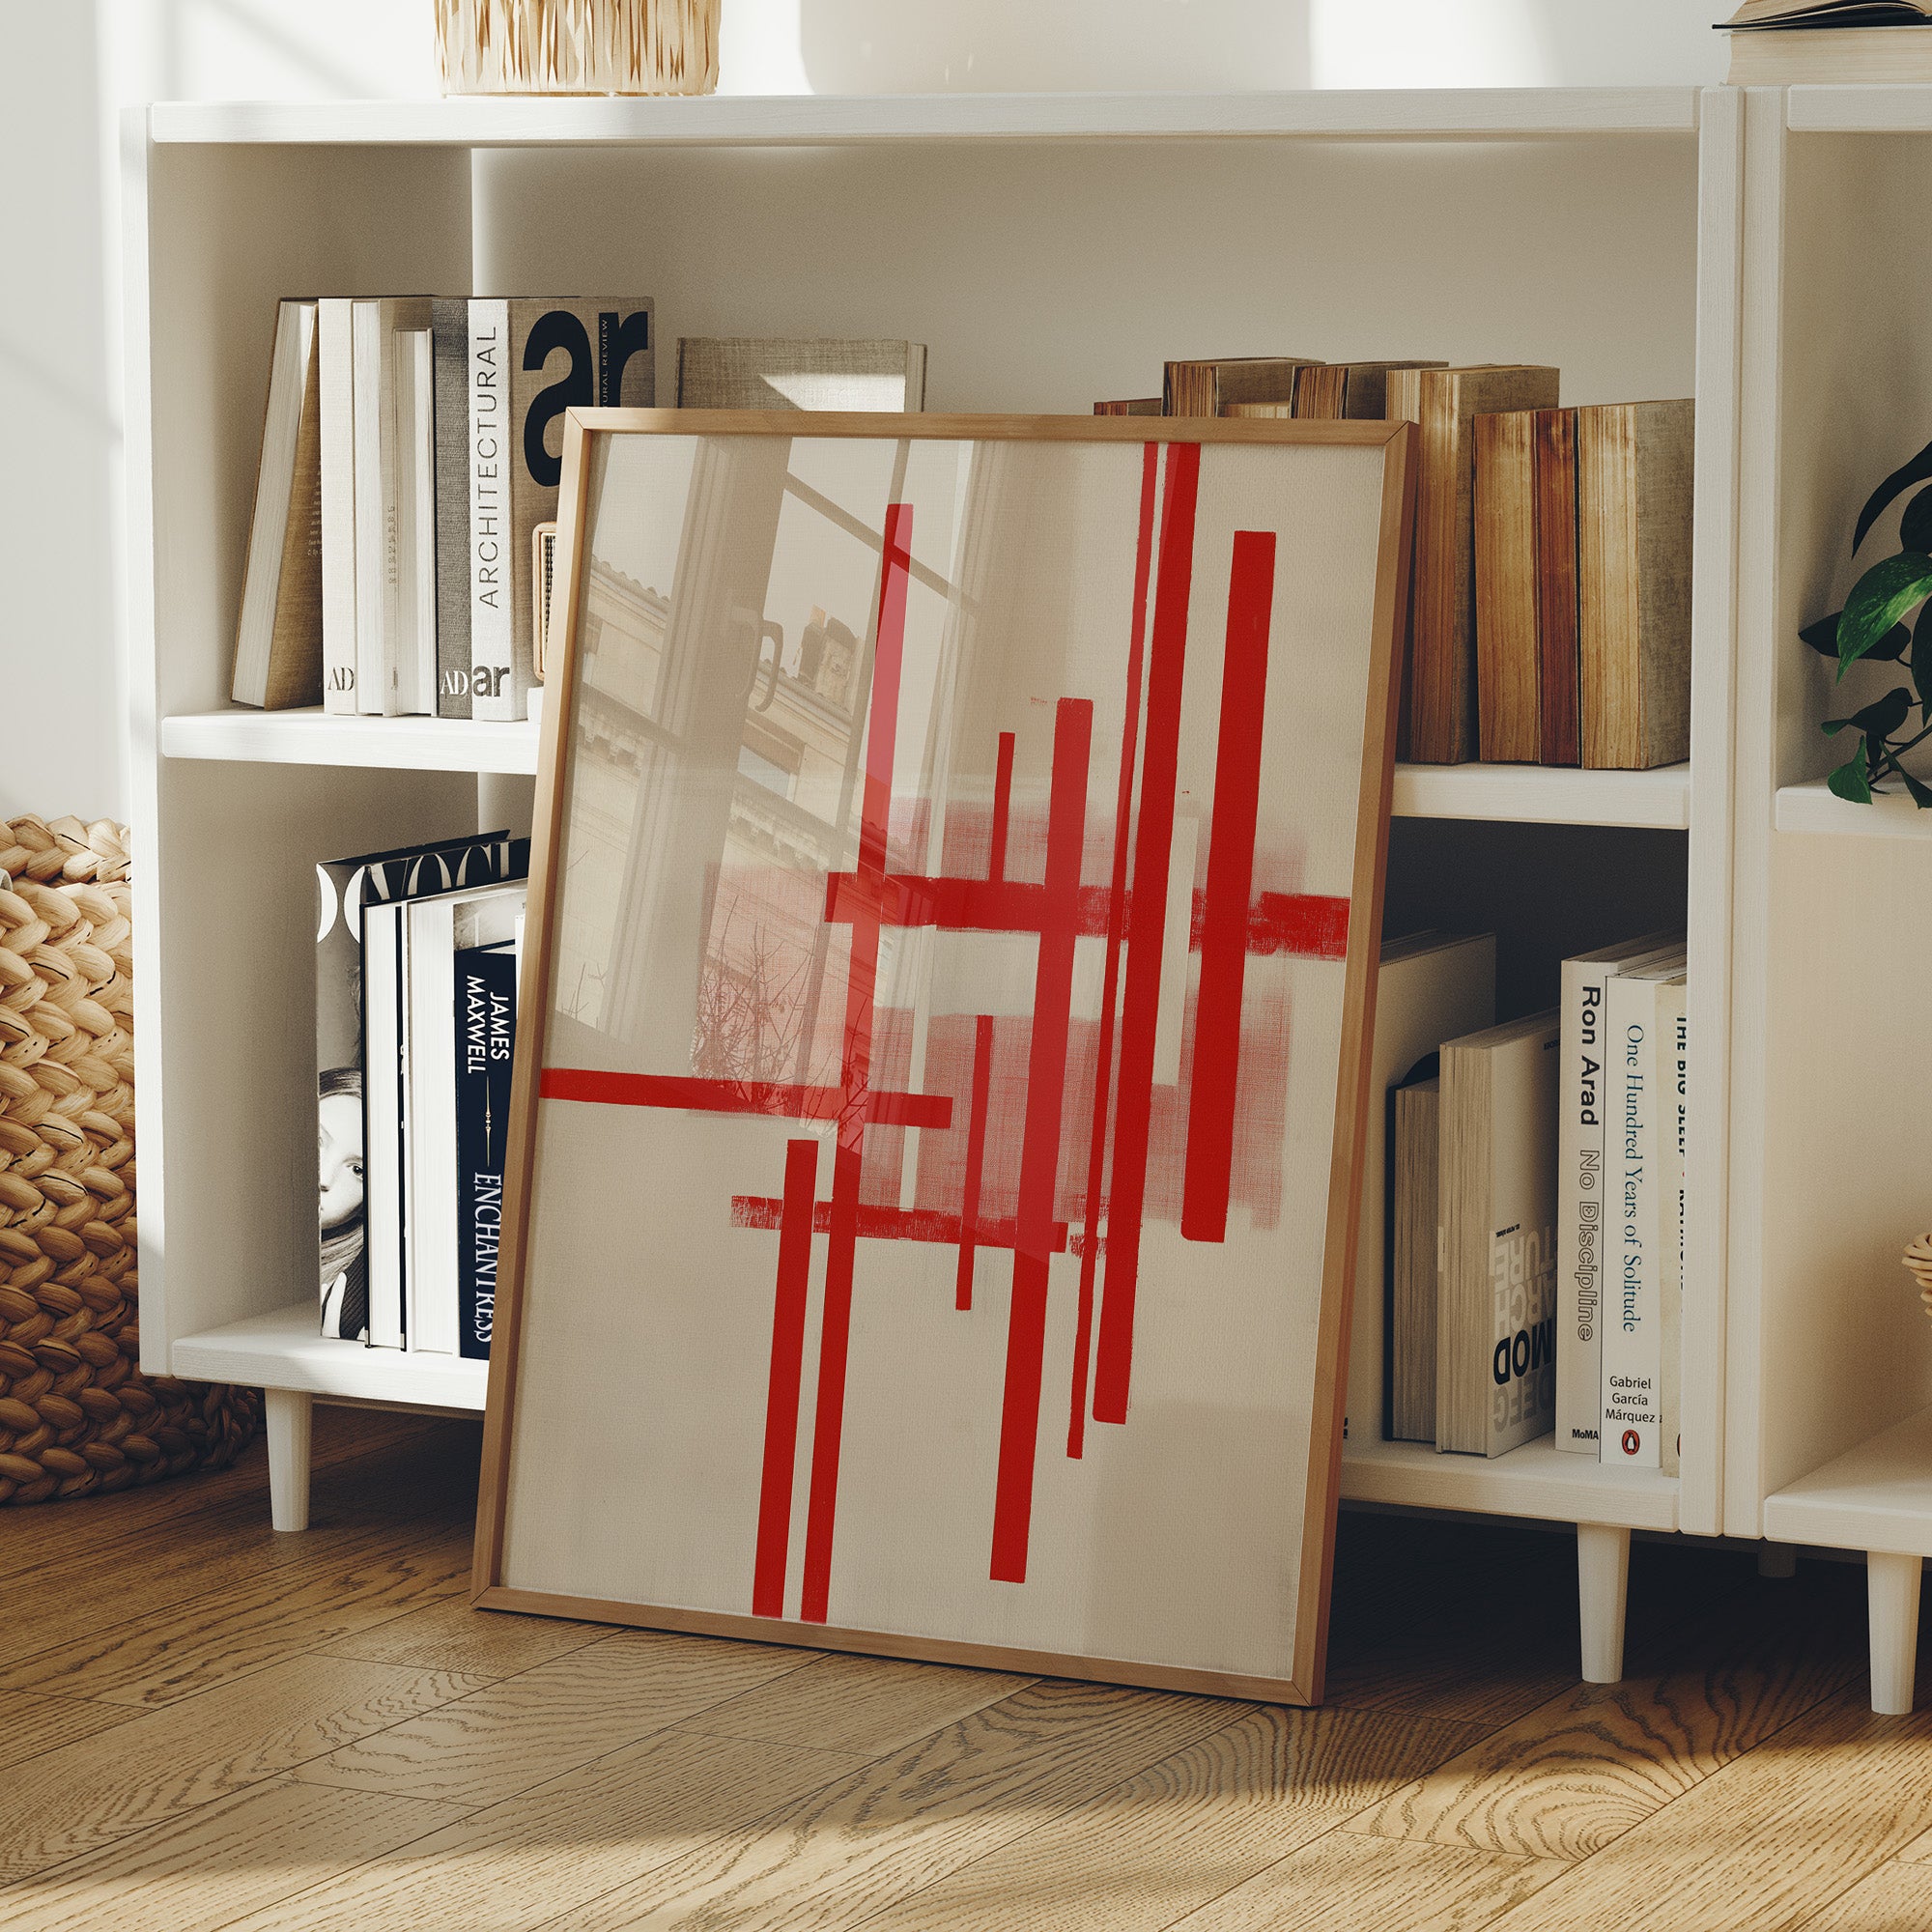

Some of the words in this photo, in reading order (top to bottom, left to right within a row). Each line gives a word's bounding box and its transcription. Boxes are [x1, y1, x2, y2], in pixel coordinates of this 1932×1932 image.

[523, 310, 649, 488] ar
[476, 327, 498, 609] ARCHITECTURAL
[327, 667, 355, 692] AD
[440, 669, 469, 696] AD
[472, 665, 510, 697] ar
[466, 975, 487, 1074] MAXWELL
[490, 991, 509, 1061] JAMES
[1581, 985, 1601, 1045] Ron
[1627, 1024, 1644, 1066] One
[1580, 1055, 1601, 1125] Arad
[1625, 1073, 1644, 1160] Hundred
[1579, 1150, 1601, 1190] No
[1624, 1166, 1643, 1218] Years
[1624, 1225, 1642, 1248] of
[1575, 1201, 1600, 1342] Discipline
[1623, 1254, 1641, 1332] Solitude
[1493, 1318, 1552, 1385] MOD
[1609, 1376, 1651, 1389] Gabriel
[1611, 1392, 1648, 1406] García
[1572, 1429, 1600, 1440] MoMA
[1605, 1408, 1656, 1424] Márquez
